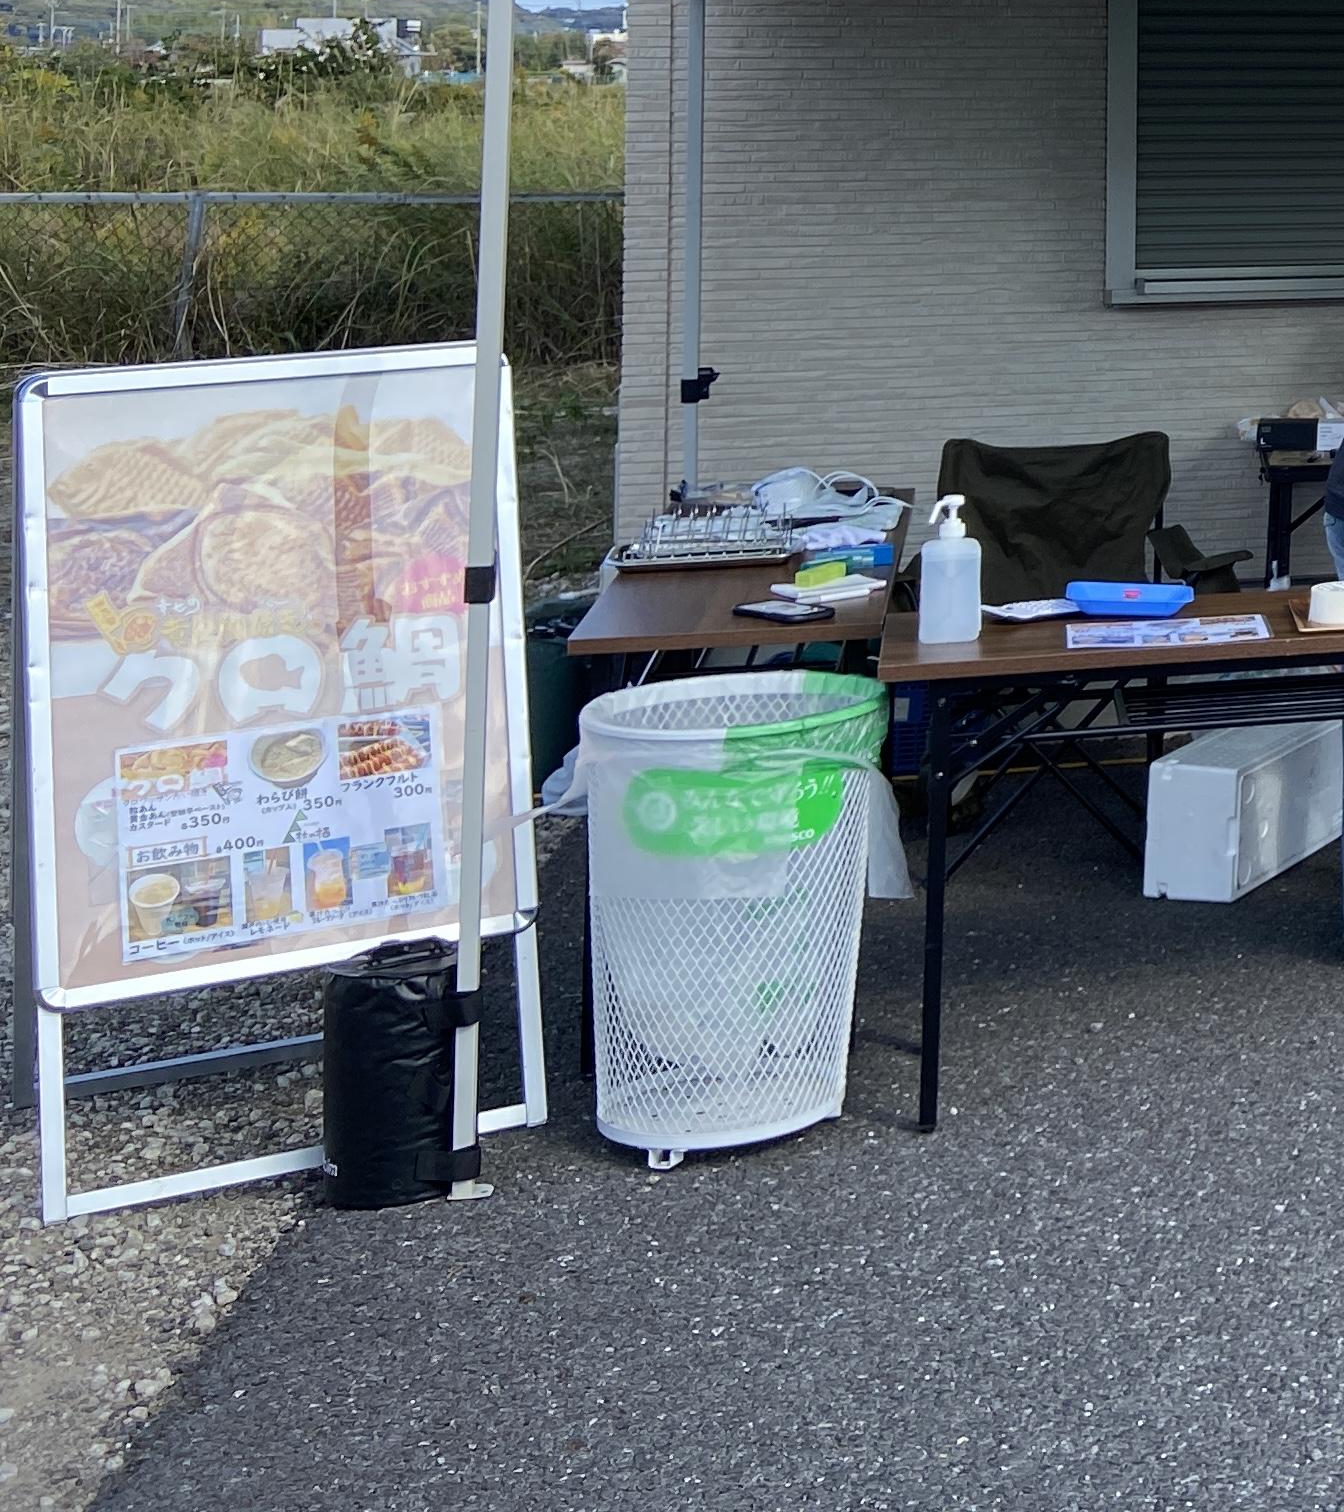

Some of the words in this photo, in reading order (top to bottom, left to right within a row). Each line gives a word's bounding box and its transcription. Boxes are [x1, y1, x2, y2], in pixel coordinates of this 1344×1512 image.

[341, 774, 419, 793] フランクフルト
[393, 784, 432, 799] 300円
[256, 788, 308, 806] わらび餅
[303, 796, 343, 812] 350円
[129, 817, 171, 832] カスタード
[136, 842, 200, 864] お飲み物
[129, 939, 180, 955] コーヒー
